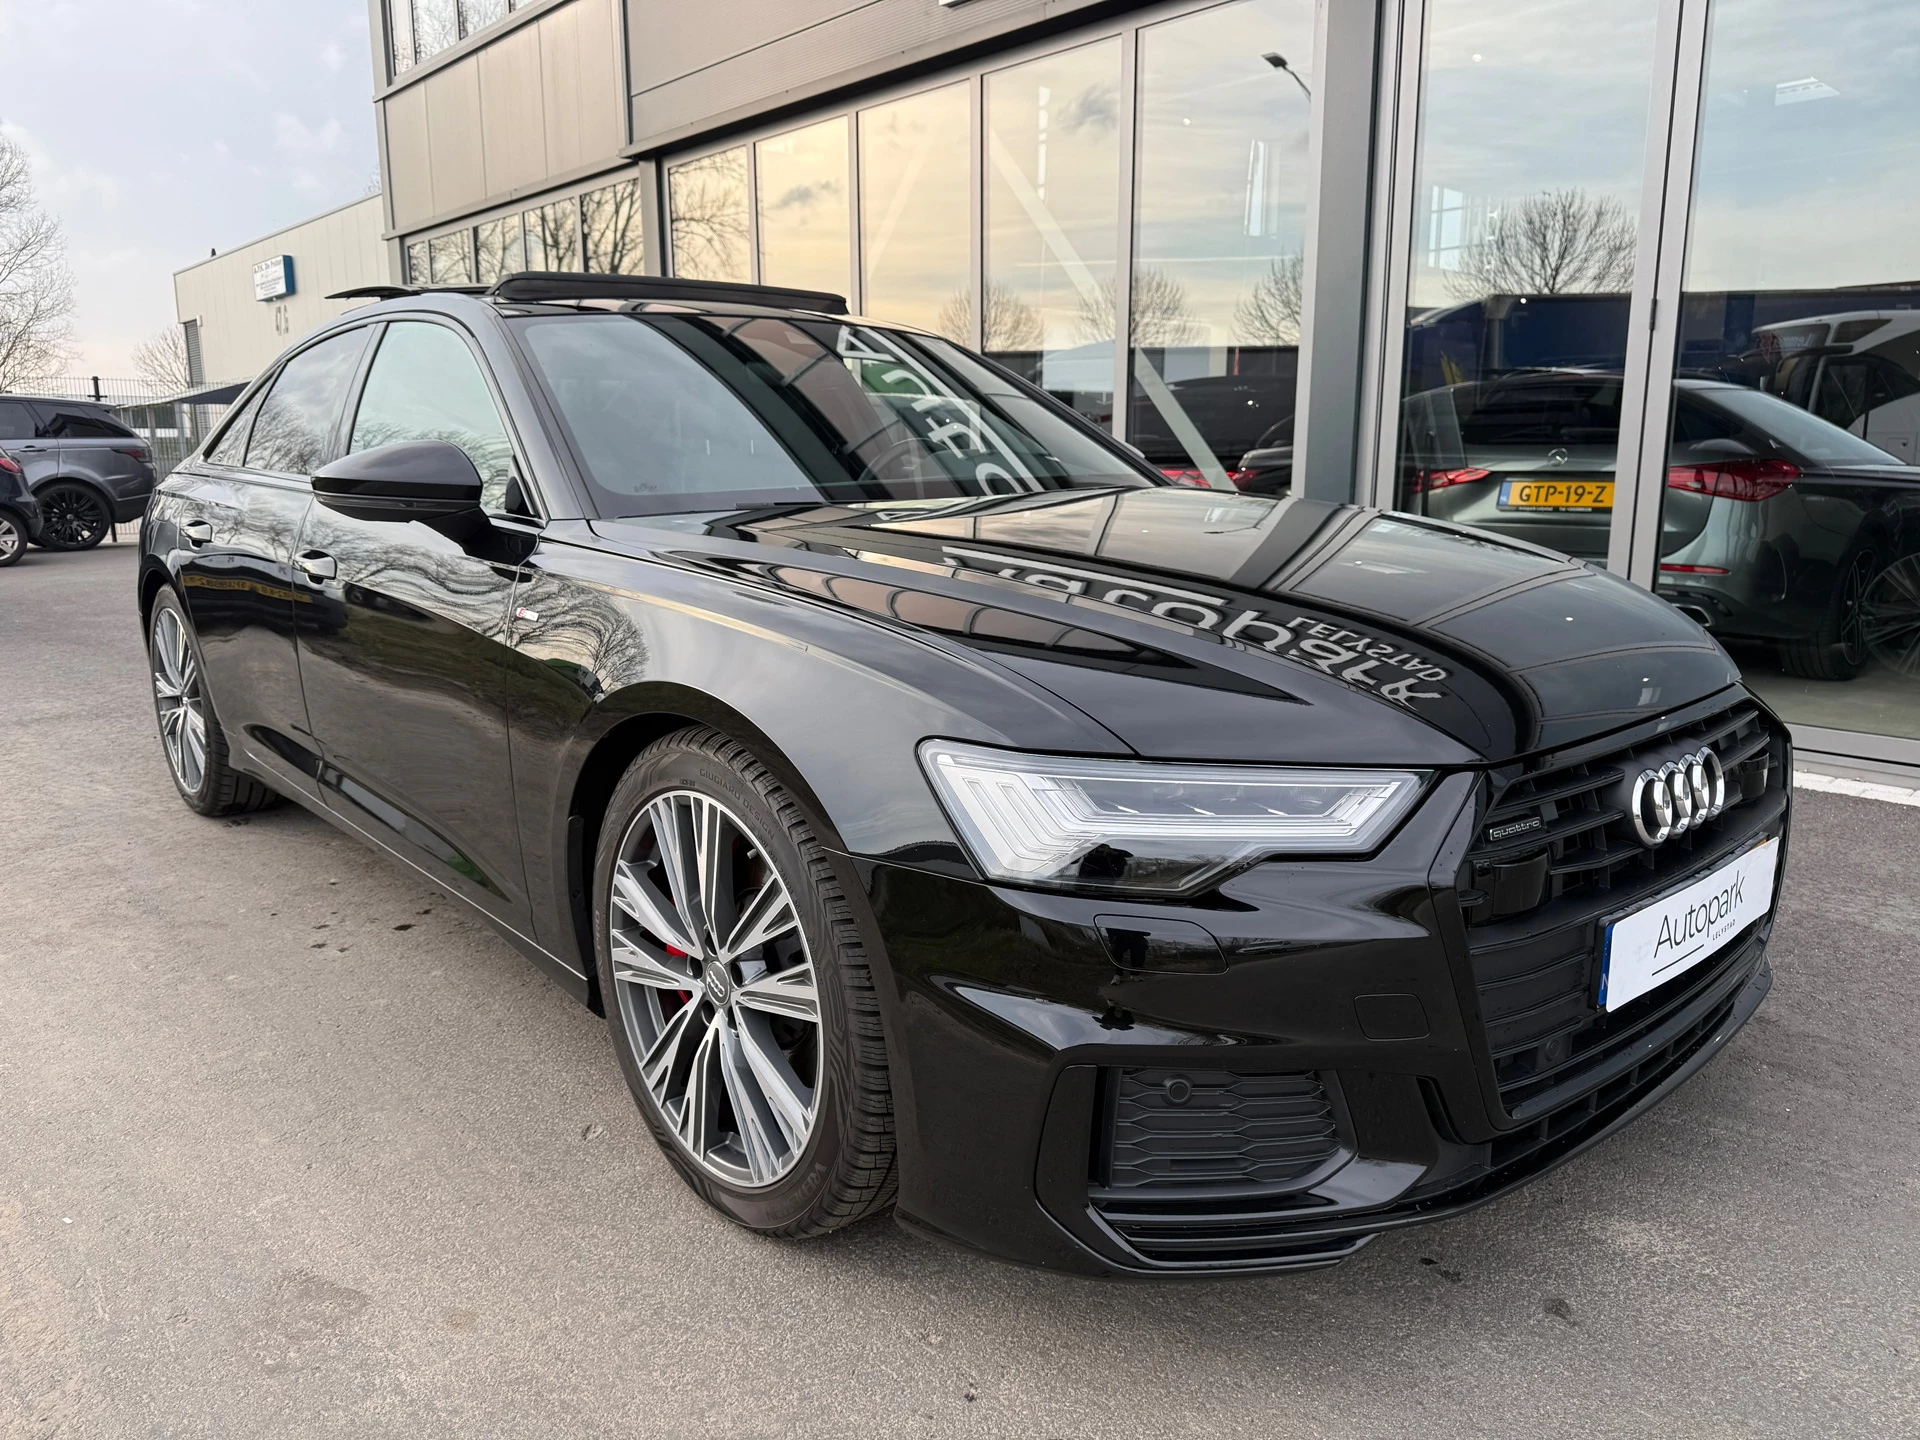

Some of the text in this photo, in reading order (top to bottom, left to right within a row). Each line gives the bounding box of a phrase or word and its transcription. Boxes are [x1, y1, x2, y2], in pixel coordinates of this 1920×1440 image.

[1519, 485, 1607, 503] GTP-19-Z
[699, 767, 775, 840] GIUGIARO DESIGN
[1493, 820, 1540, 839] quattro
[1653, 870, 1745, 958] Autopark
[1712, 918, 1736, 941] LELYSTAD
